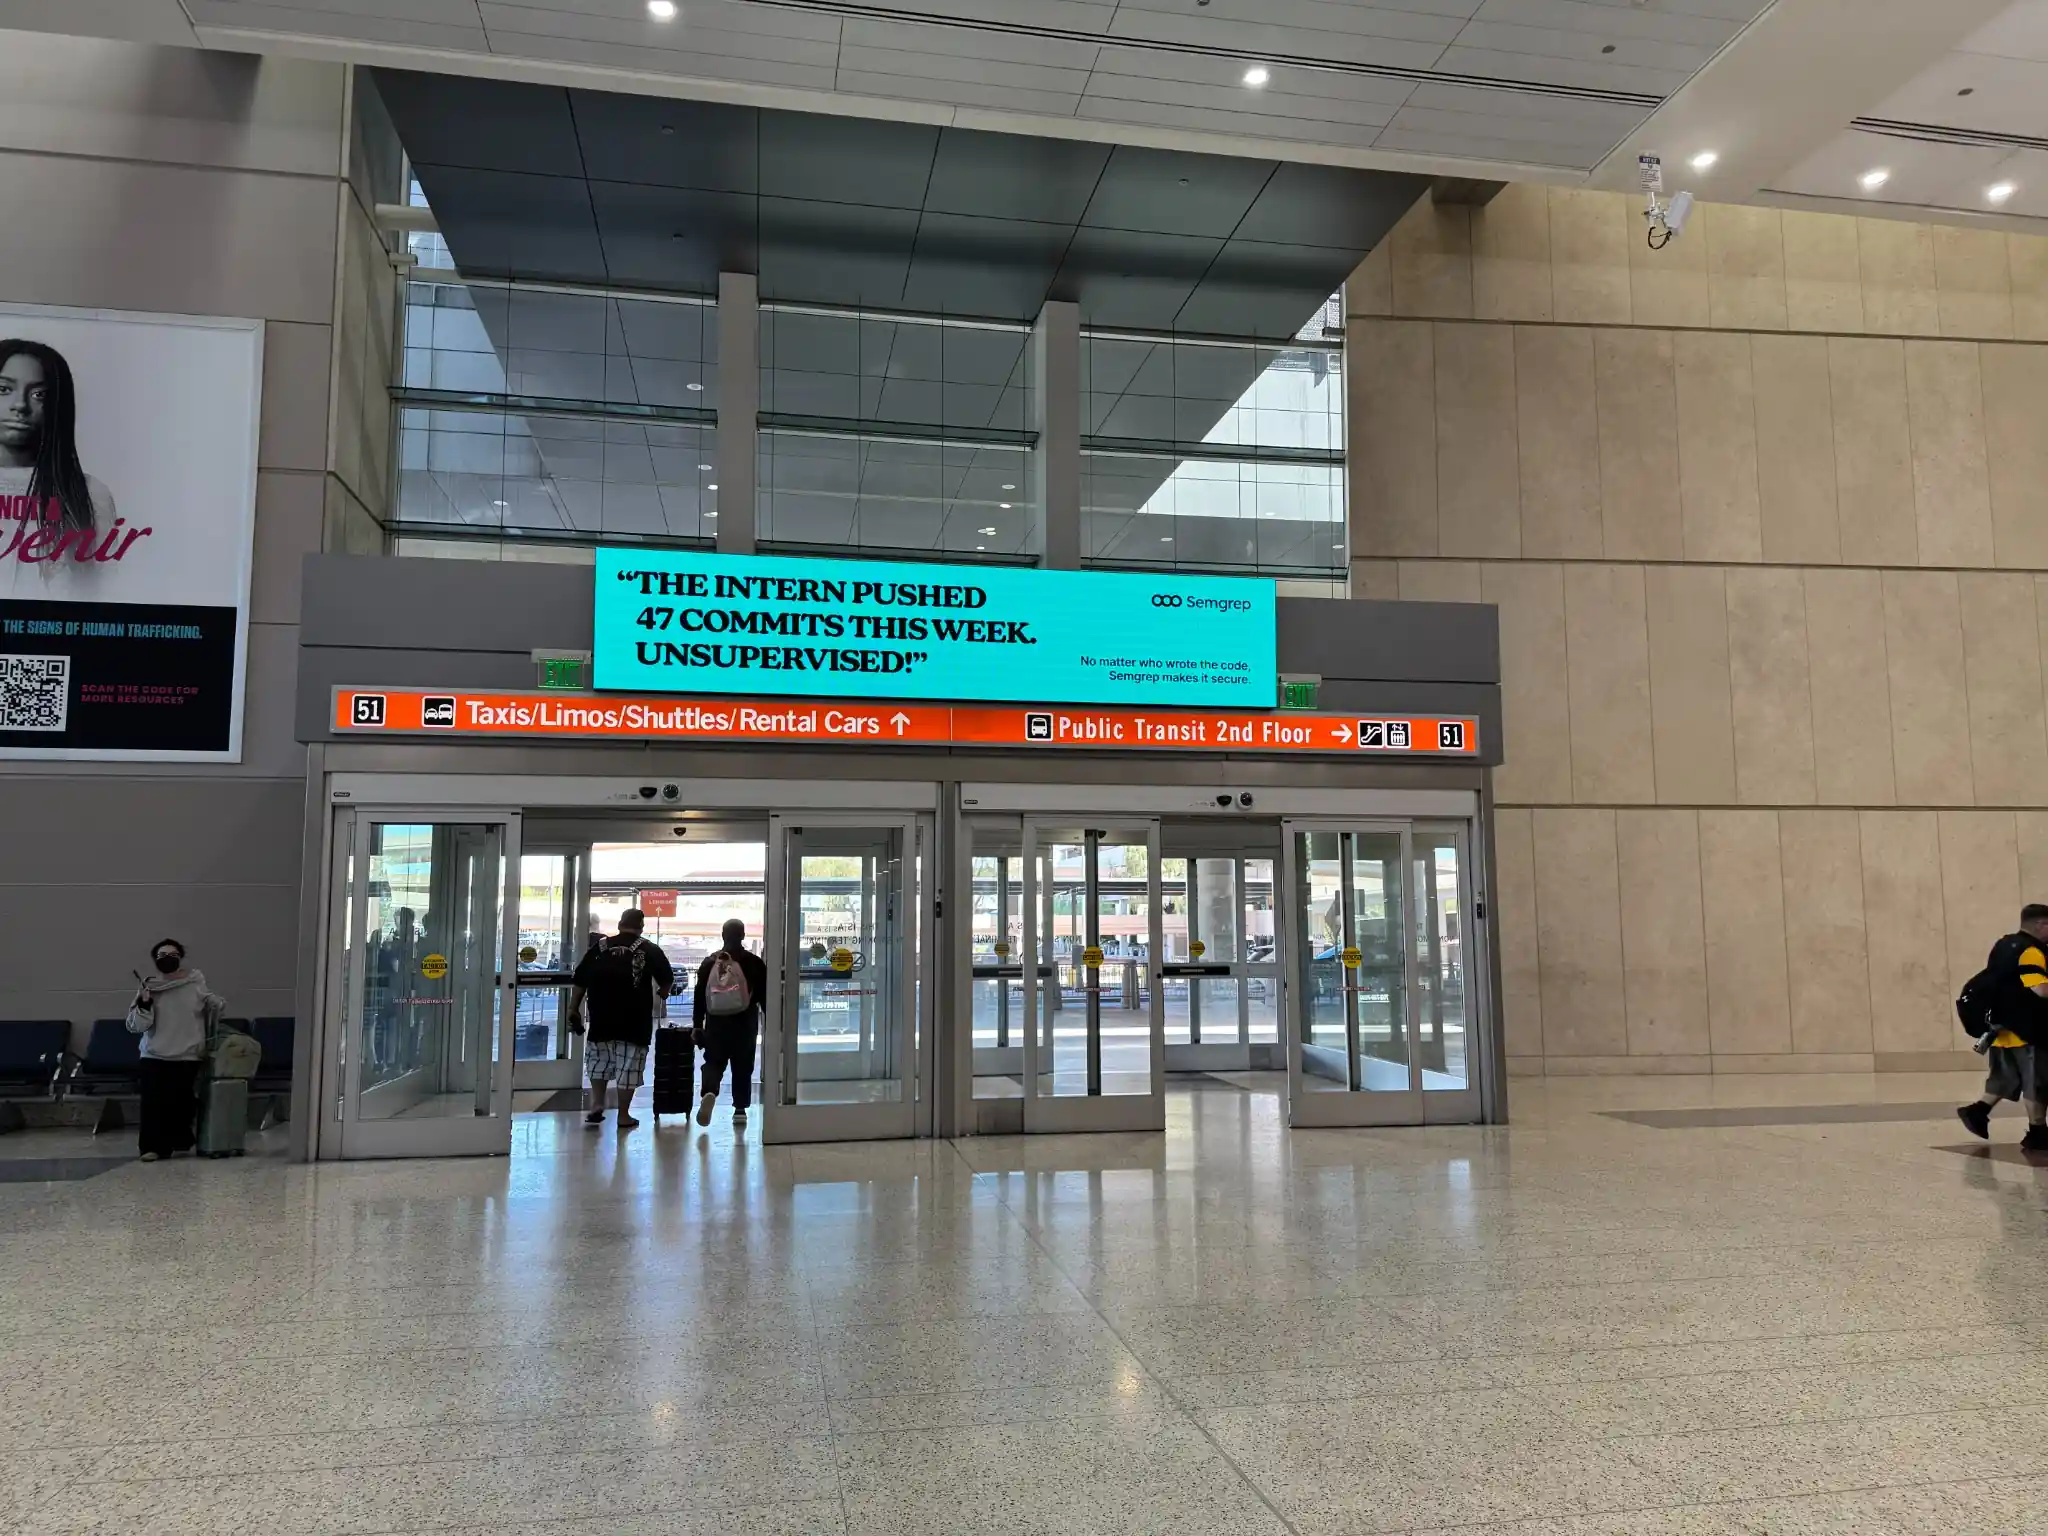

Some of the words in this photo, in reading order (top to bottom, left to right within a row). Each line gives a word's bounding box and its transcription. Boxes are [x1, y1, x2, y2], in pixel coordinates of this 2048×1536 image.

[714, 574, 847, 603] INTERN
[852, 581, 987, 609] PUSHED
[1186, 595, 1252, 612] Semgrep
[3, 620, 24, 634] THE
[27, 621, 62, 635] SIGNS
[65, 622, 80, 635] OF
[82, 623, 124, 637] HUMAN
[128, 624, 203, 639] TRAFFICKING.
[636, 607, 674, 631] 47
[679, 609, 844, 637] COMMITS
[847, 615, 928, 641] THIS
[931, 618, 1037, 645] WEEK.
[1080, 656, 1097, 666] No
[1100, 657, 1137, 667] matter
[1139, 659, 1163, 669] who
[1165, 660, 1198, 669] wrote
[1200, 661, 1219, 670] the
[1221, 661, 1252, 673] code,
[1108, 671, 1161, 683] Semgrep
[1162, 673, 1199, 683] makes
[1201, 674, 1209, 683] it
[1211, 674, 1252, 684] secure.
[81, 684, 115, 692] SCAN
[118, 685, 139, 693] THE
[81, 694, 113, 703] MORE
[357, 699, 380, 721] 51
[824, 711, 880, 734] Cars
[1059, 716, 1124, 740] Public
[1134, 718, 1206, 742] Transit
[1216, 720, 1253, 742] 2nd
[1263, 721, 1312, 744] Floor
[1443, 728, 1462, 746] 51
